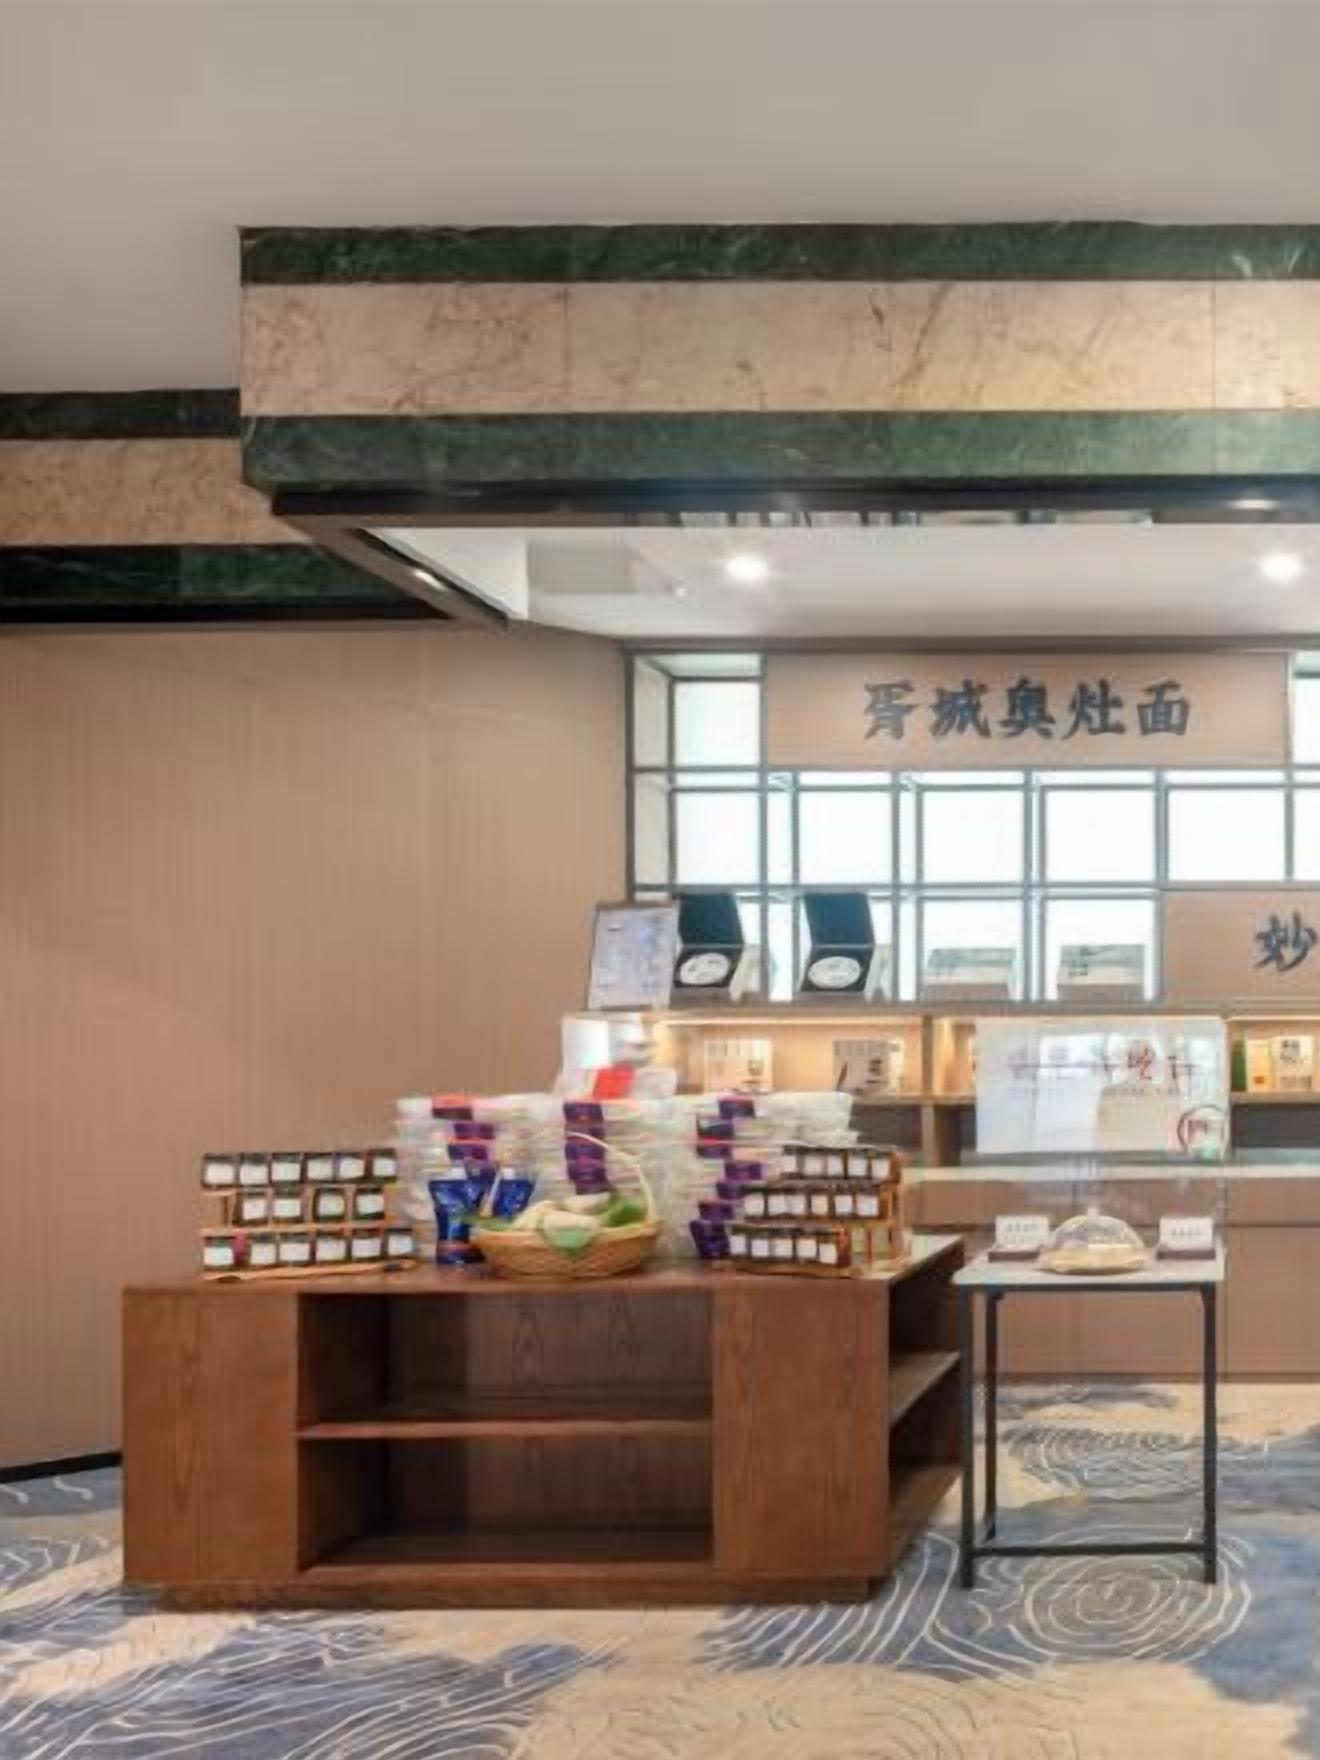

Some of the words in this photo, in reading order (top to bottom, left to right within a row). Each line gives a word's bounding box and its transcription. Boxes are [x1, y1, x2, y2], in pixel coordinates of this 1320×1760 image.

[863, 675, 1192, 741] 胥城奥灶面
